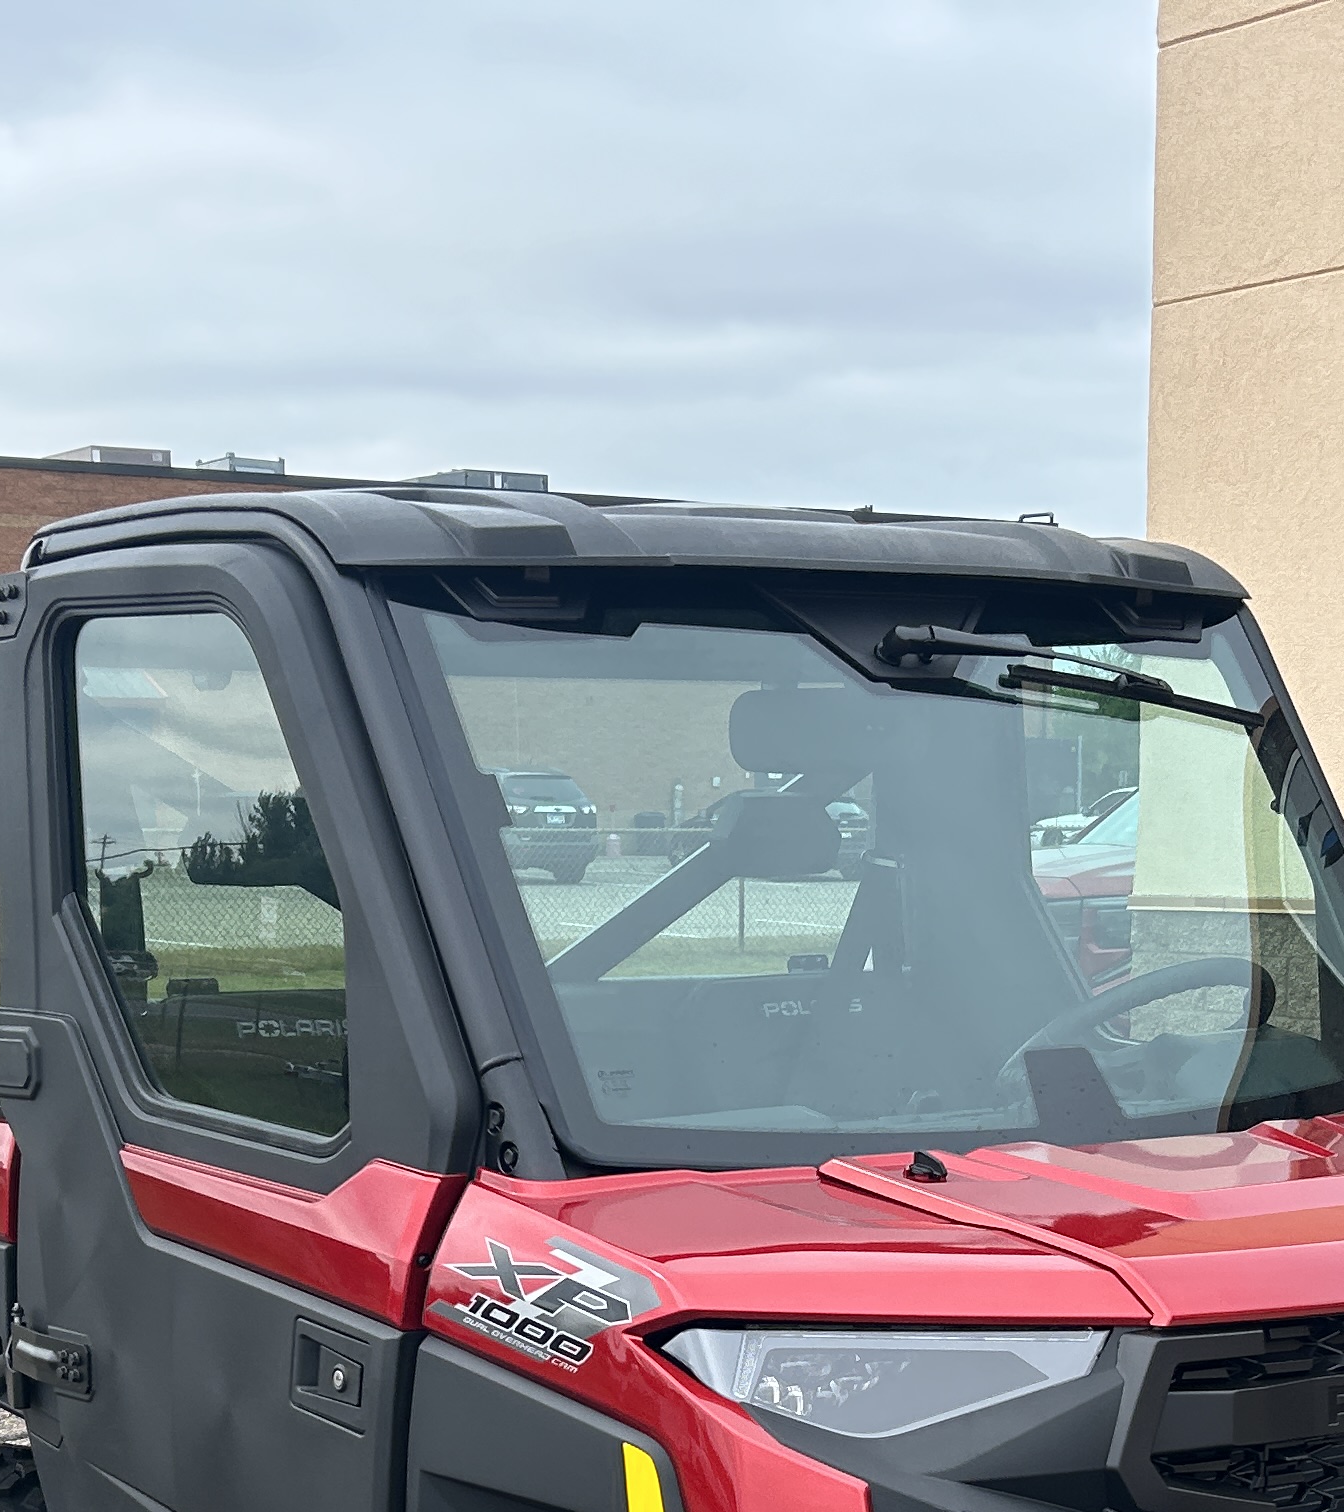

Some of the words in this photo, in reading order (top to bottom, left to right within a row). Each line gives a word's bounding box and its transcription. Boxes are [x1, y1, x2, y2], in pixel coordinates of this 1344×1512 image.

[762, 998, 863, 1019] POLS
[442, 1236, 633, 1326] XP
[462, 1316, 490, 1334] DUAL
[490, 1329, 552, 1361] OVERHEAD
[551, 1358, 578, 1374] CAM
[465, 1293, 594, 1366] 1000
